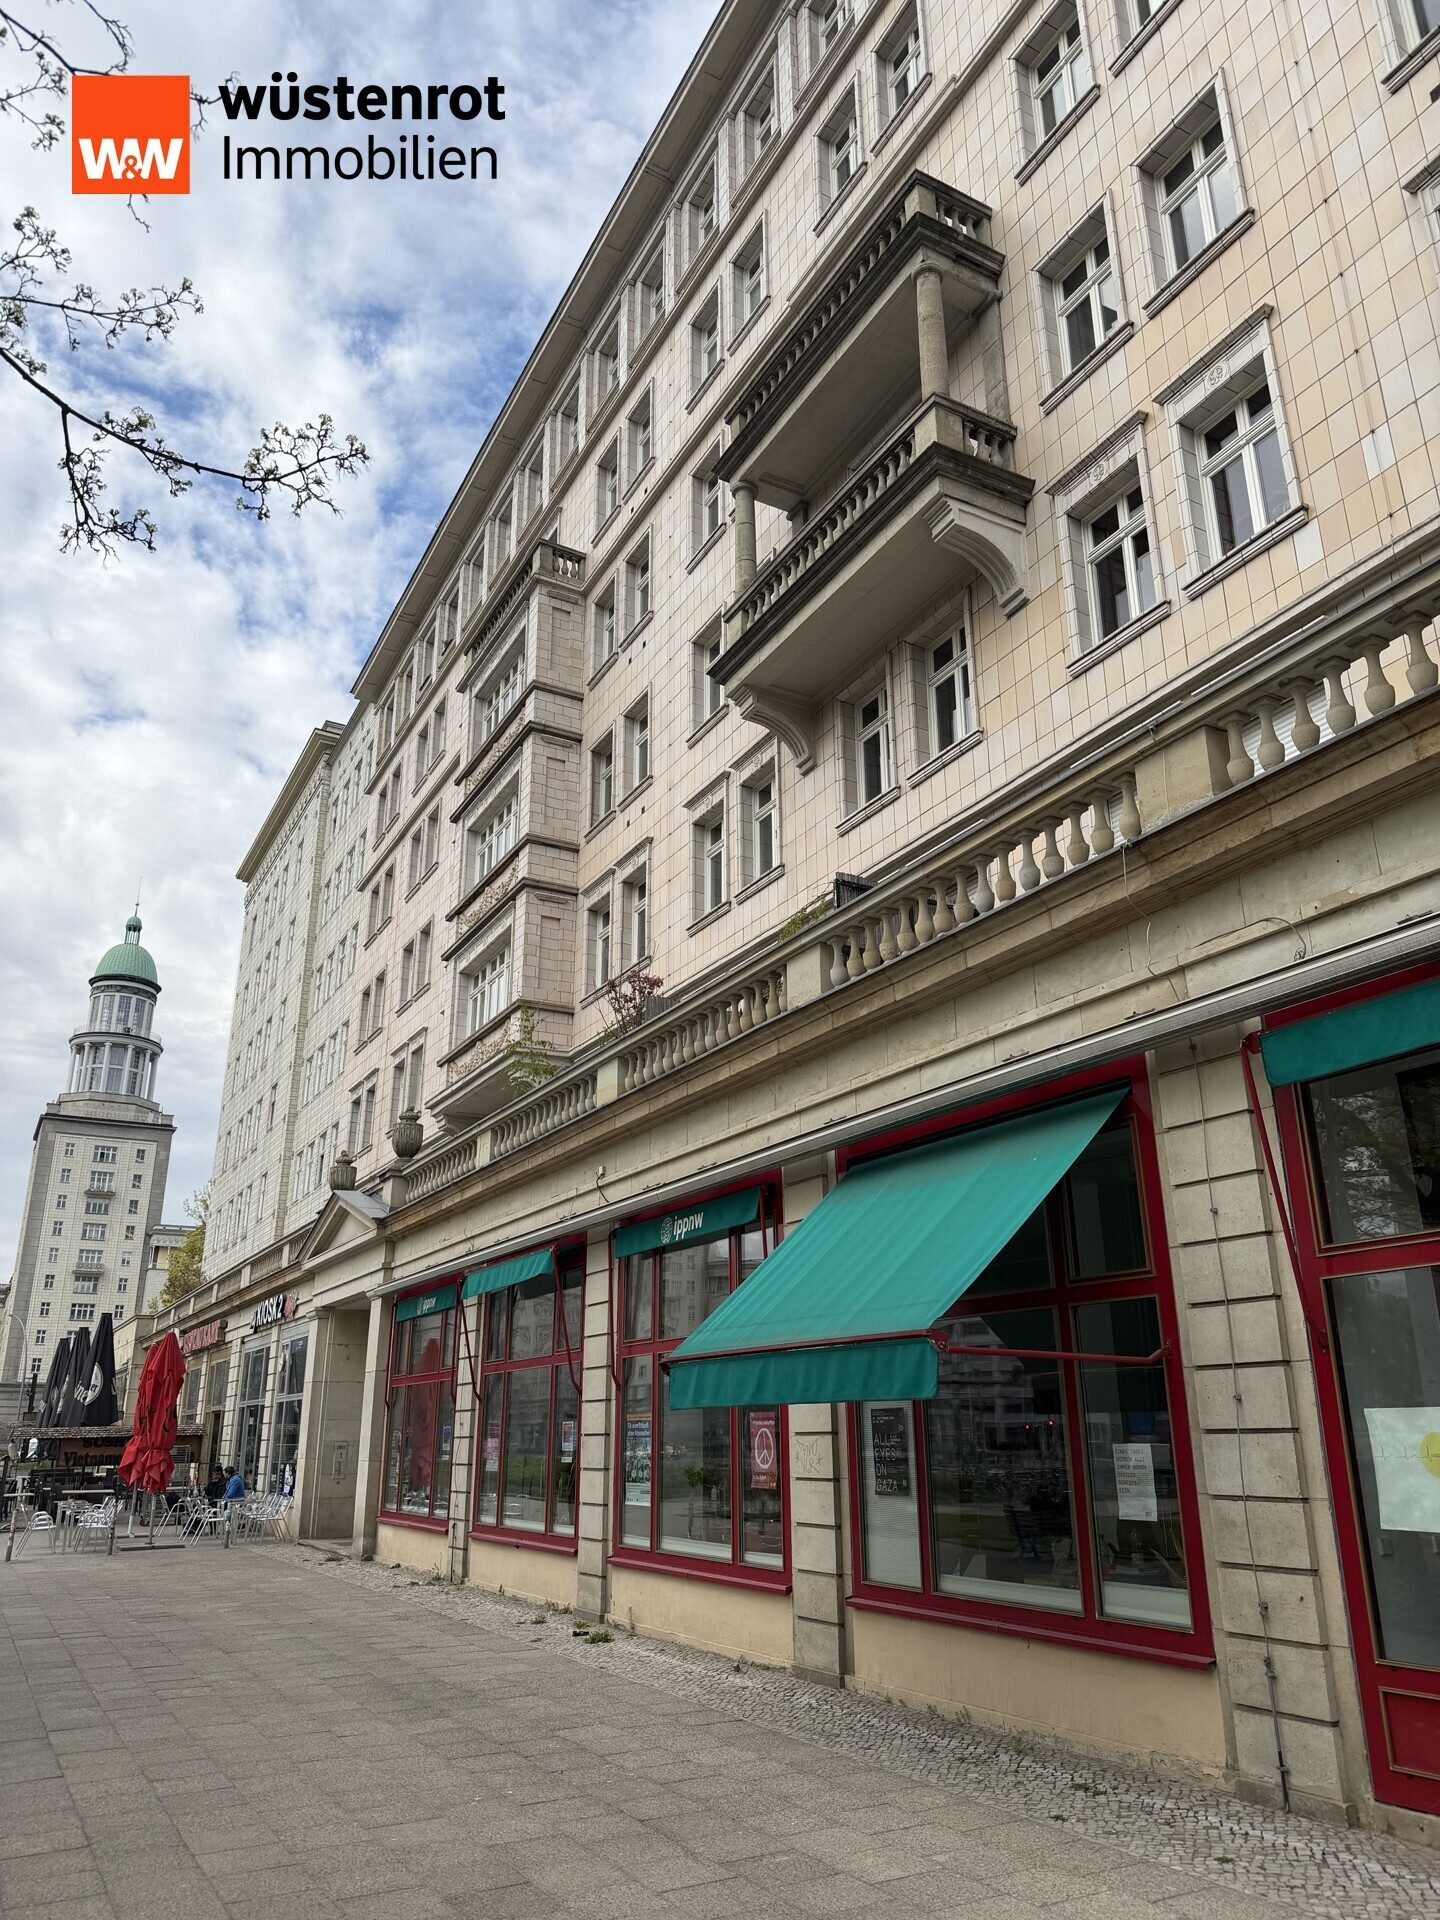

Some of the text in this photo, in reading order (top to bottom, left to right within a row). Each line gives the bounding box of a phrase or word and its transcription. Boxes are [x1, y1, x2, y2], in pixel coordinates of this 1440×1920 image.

[673, 1211, 704, 1241] ippnw
[256, 1294, 283, 1326] KIOSK 2
[874, 1433, 891, 1447] ALL
[874, 1447, 897, 1461] EYES
[876, 1463, 887, 1476] ON
[876, 1478, 898, 1492] GAZA
